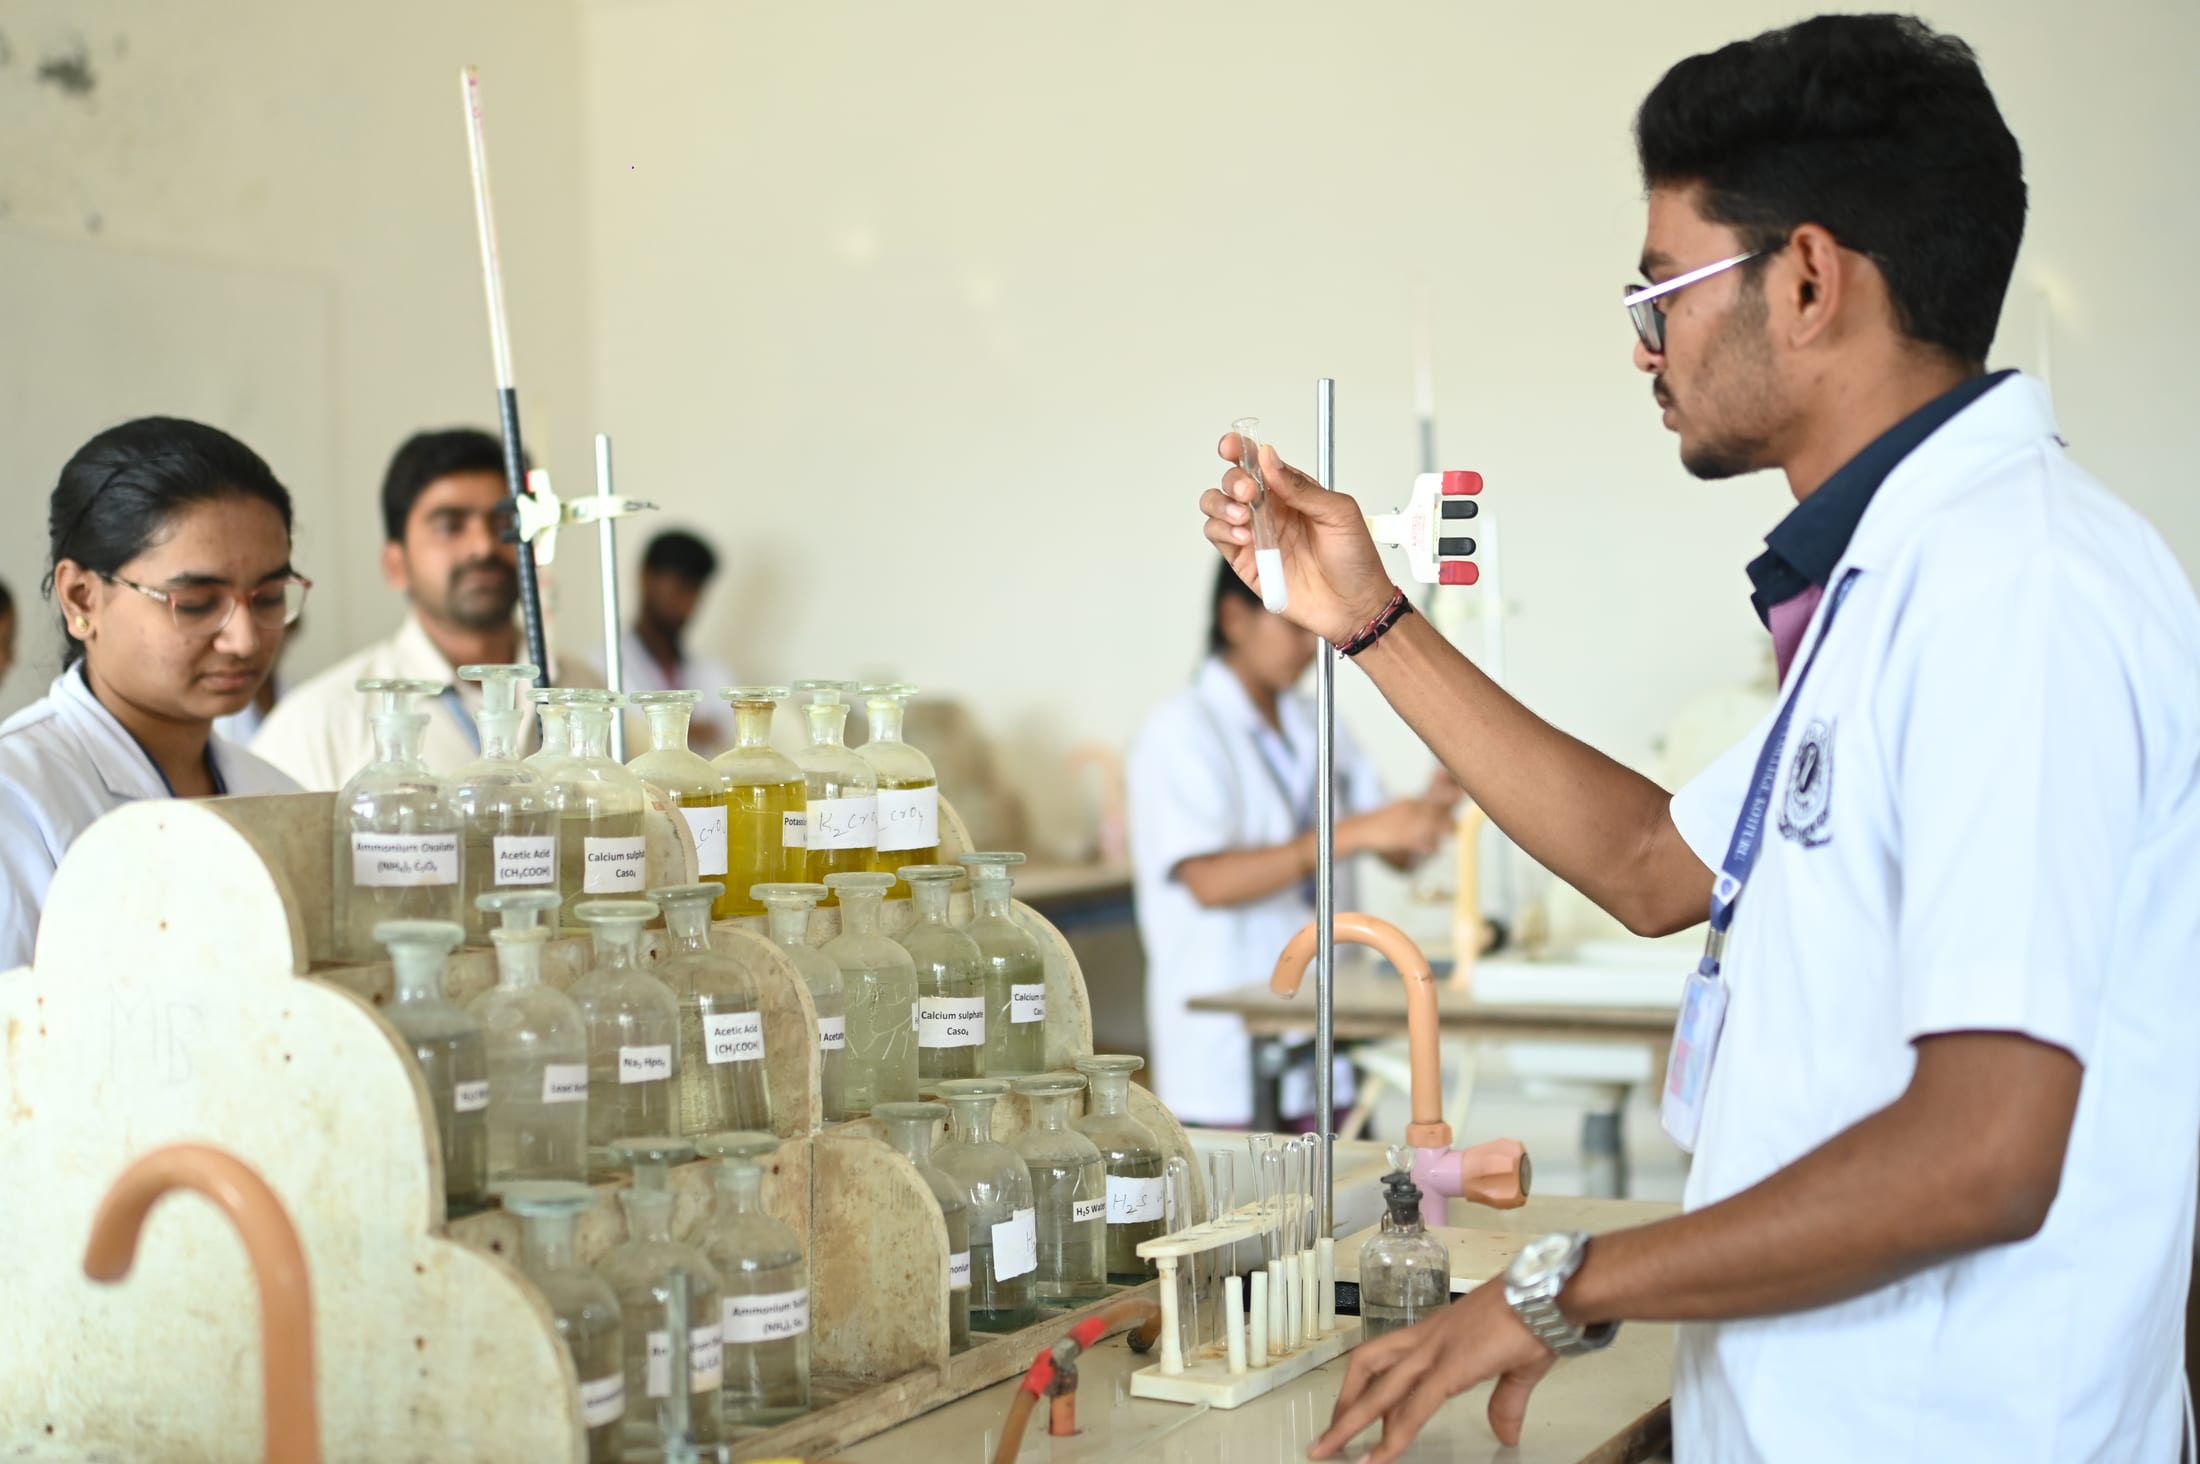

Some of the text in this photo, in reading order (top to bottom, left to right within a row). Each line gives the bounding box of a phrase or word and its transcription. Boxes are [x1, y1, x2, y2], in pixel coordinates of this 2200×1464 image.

[500, 849, 550, 860] Acetic Acid
[588, 852, 624, 862] Calcium
[921, 1011, 957, 1020] Calcium
[714, 1025, 758, 1037] Acetic Acid
